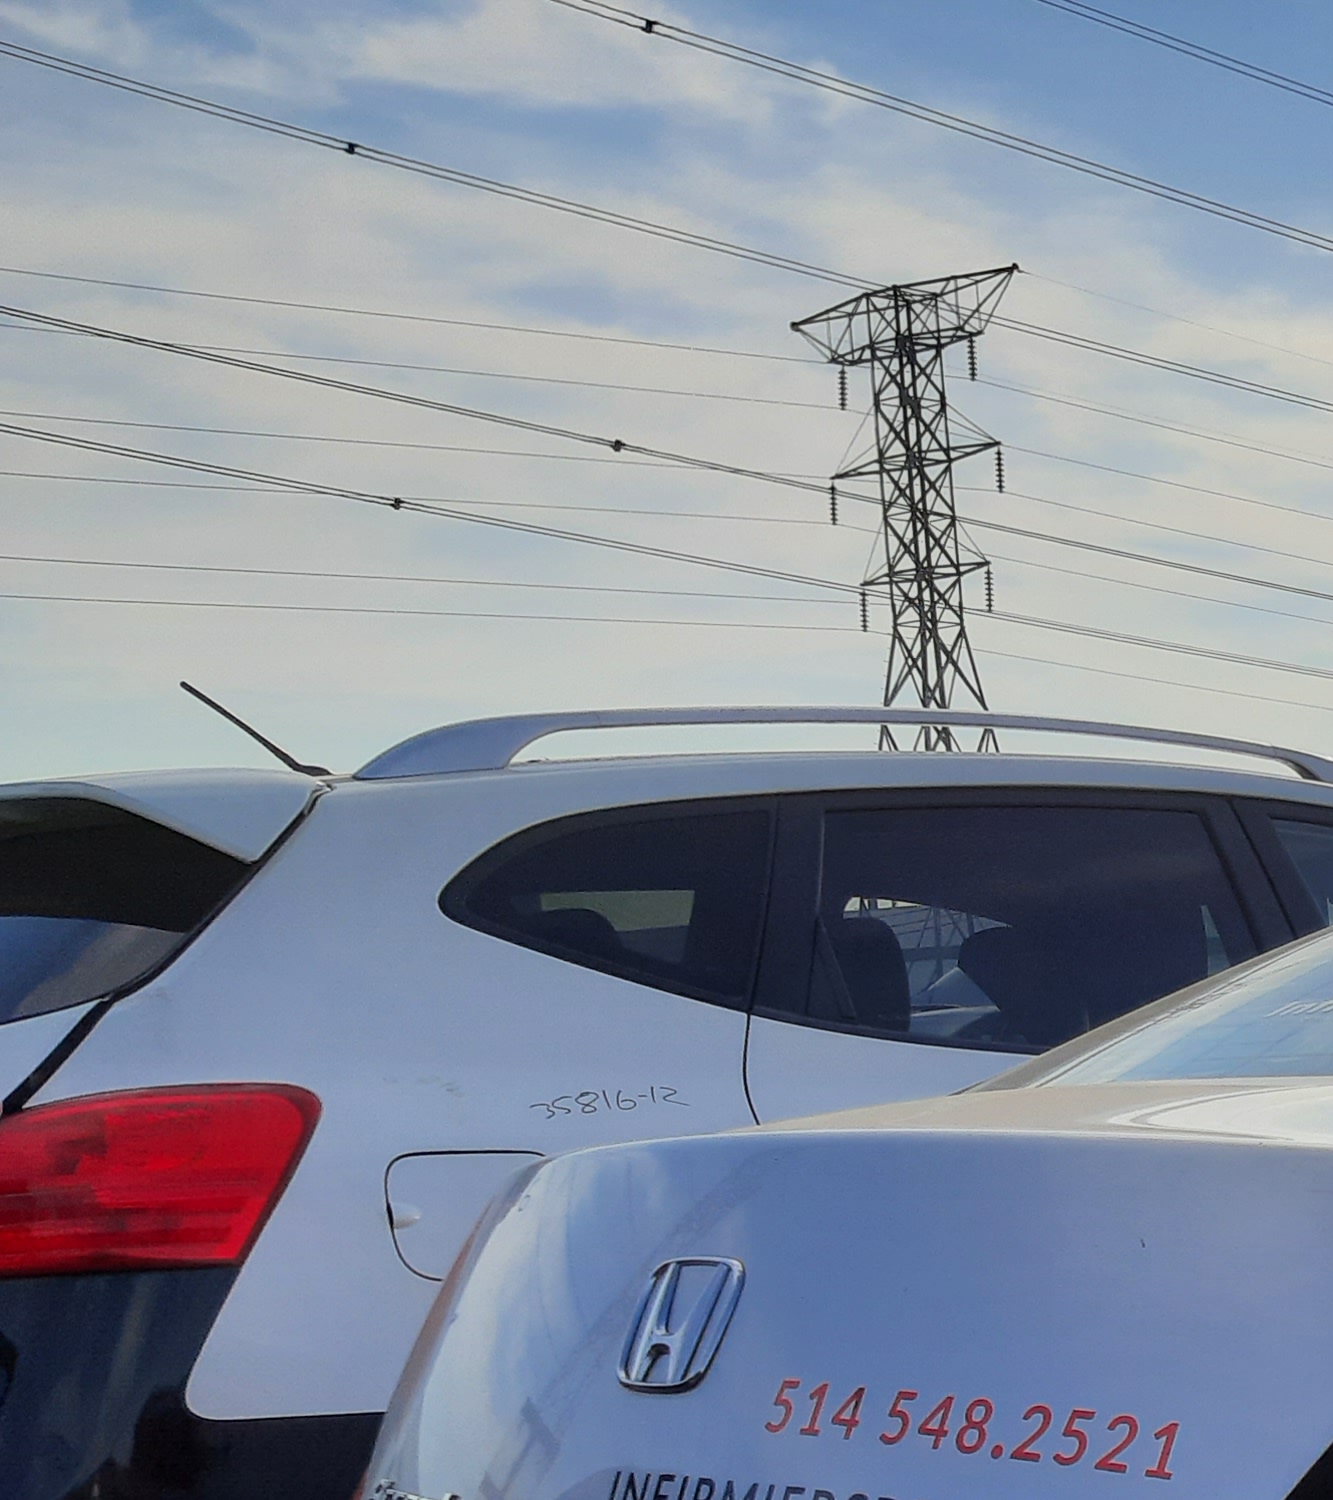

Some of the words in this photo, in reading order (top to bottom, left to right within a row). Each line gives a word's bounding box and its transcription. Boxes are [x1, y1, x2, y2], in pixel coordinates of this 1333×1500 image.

[529, 1086, 690, 1119] 35816-12
[765, 1378, 865, 1438] 514
[879, 1389, 1182, 1481] 548.2521
